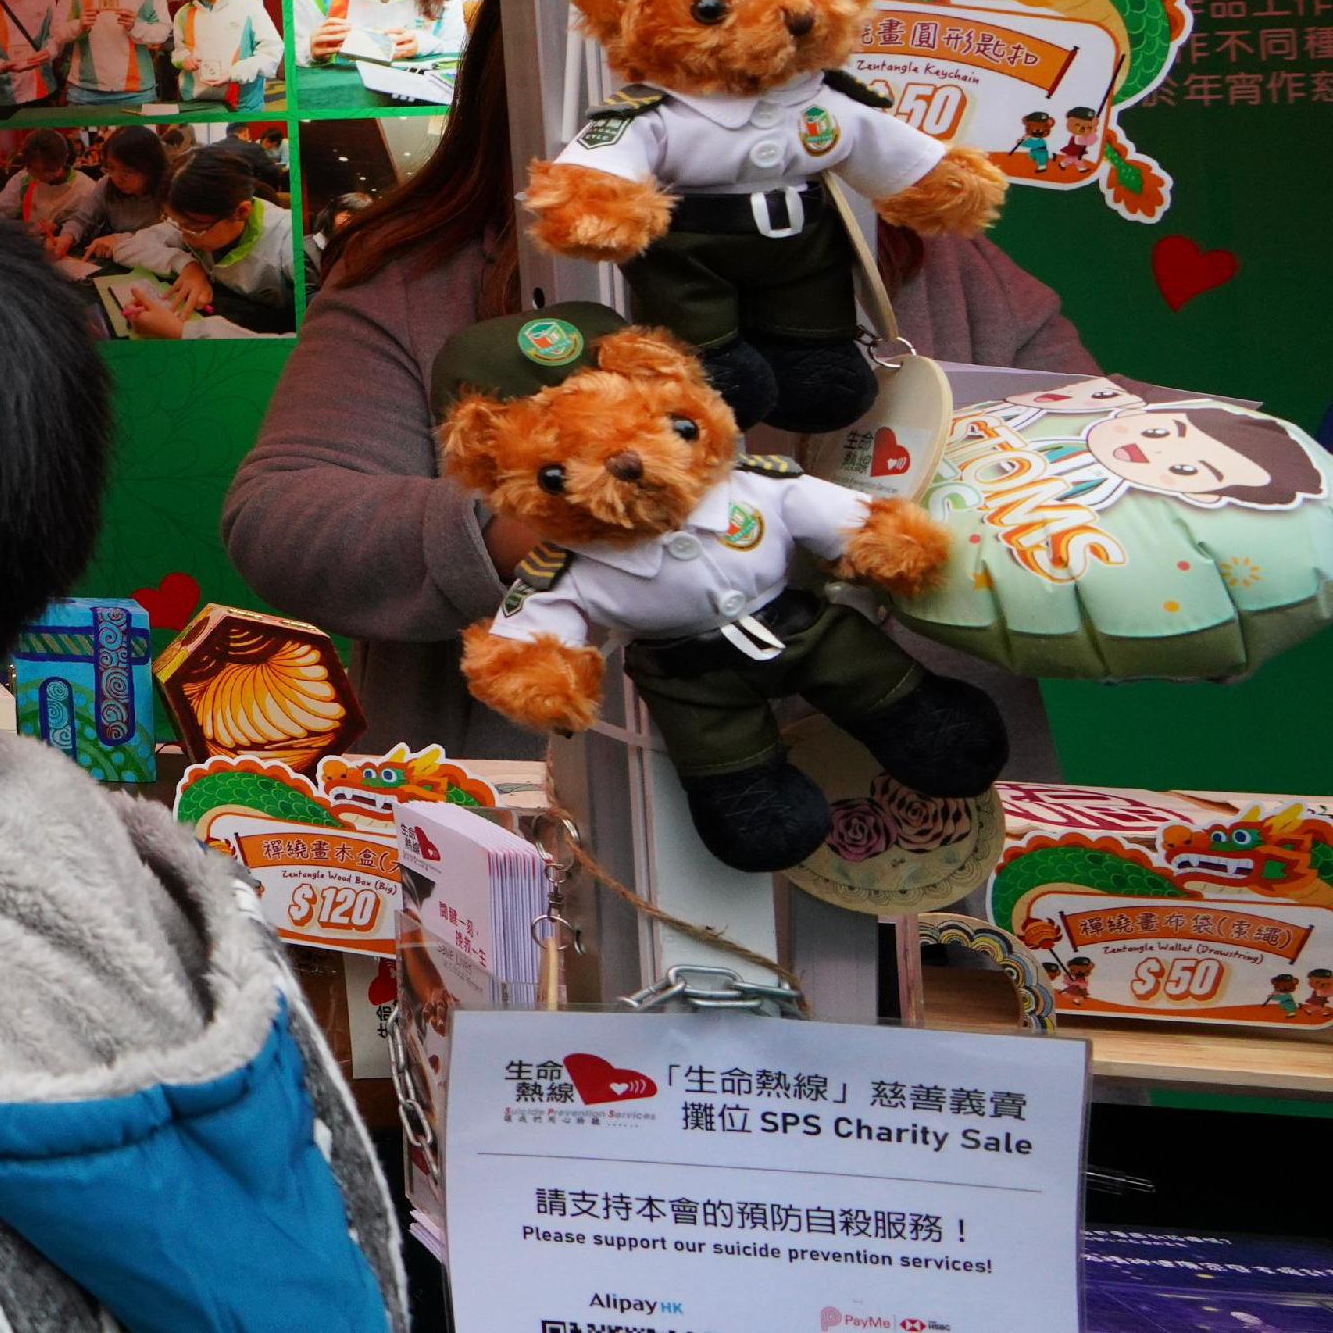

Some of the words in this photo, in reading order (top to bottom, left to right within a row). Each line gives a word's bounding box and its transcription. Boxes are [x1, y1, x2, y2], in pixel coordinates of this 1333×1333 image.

[923, 62, 982, 85] Keychain
[282, 869, 325, 880] Zentangle
[327, 868, 352, 883] Wood
[355, 874, 372, 887] Box
[374, 879, 398, 896] (Big)
[288, 882, 381, 933] $120
[1156, 940, 1194, 954] Wallet
[1132, 956, 1225, 1002] $50
[505, 1059, 564, 1082] 生命
[516, 1081, 576, 1104] 熱線
[668, 1063, 848, 1106] 「生命熱線」
[870, 1079, 1029, 1122] 慈善義賣
[504, 1106, 545, 1116] Suicide
[547, 1106, 607, 1118] Prevention
[608, 1108, 657, 1121] Services
[681, 1100, 753, 1134] 攤位
[760, 1110, 823, 1137] SPS
[833, 1116, 950, 1154] Charity
[960, 1127, 1034, 1156] Sale
[522, 1225, 587, 1246] Please
[592, 1232, 669, 1253] support
[673, 1239, 707, 1255] our
[711, 1239, 782, 1260] suicide
[787, 1244, 894, 1267] prevention
[899, 1252, 993, 1275] services!
[844, 1313, 892, 1330] PayMe
